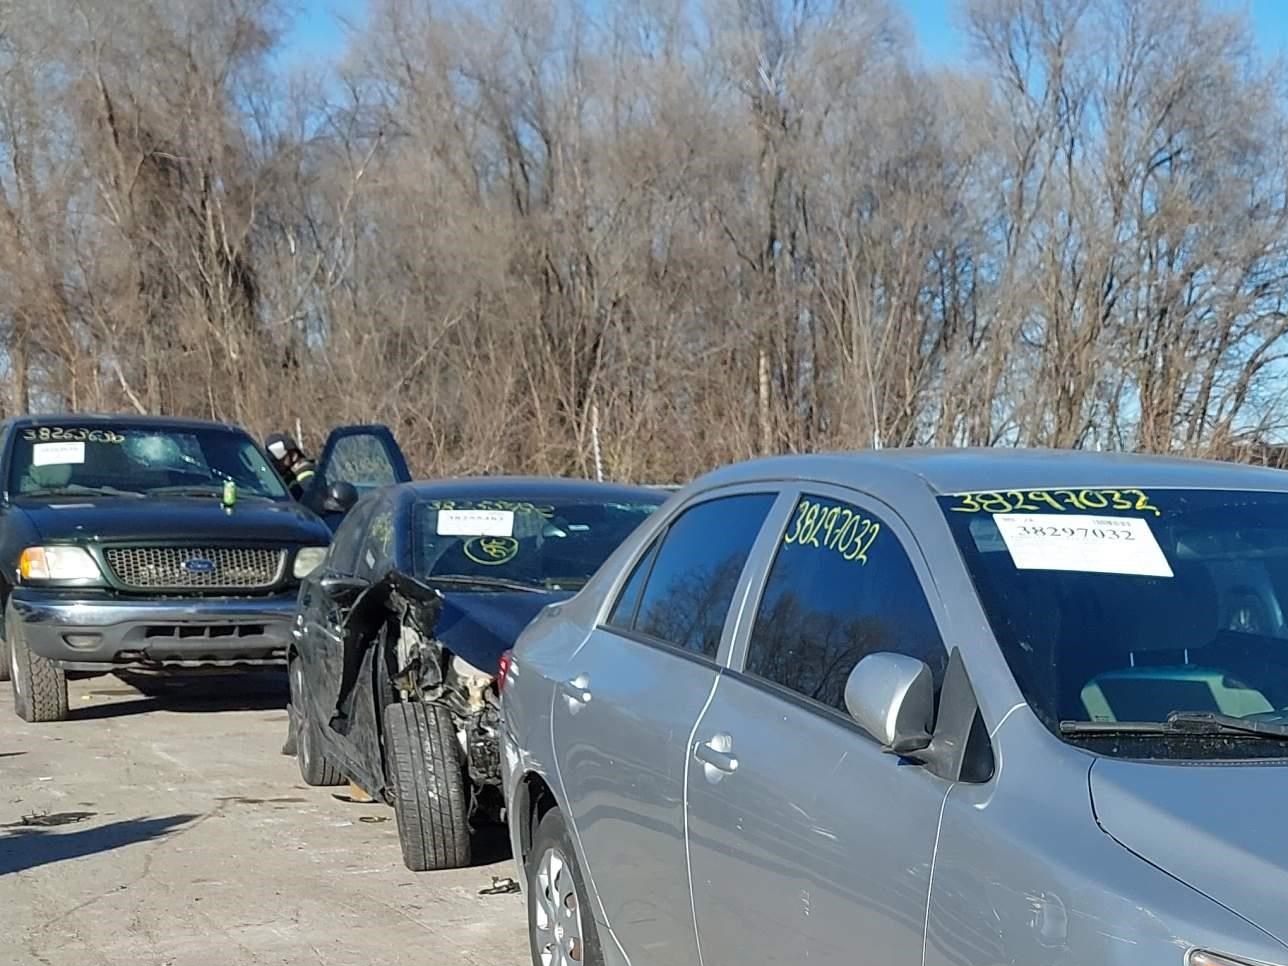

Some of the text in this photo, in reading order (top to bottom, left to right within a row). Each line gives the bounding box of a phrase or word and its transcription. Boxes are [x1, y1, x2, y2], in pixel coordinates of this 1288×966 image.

[950, 489, 1160, 516] 38297032
[785, 501, 880, 566] 38297032
[1017, 525, 1137, 541] 38297032
